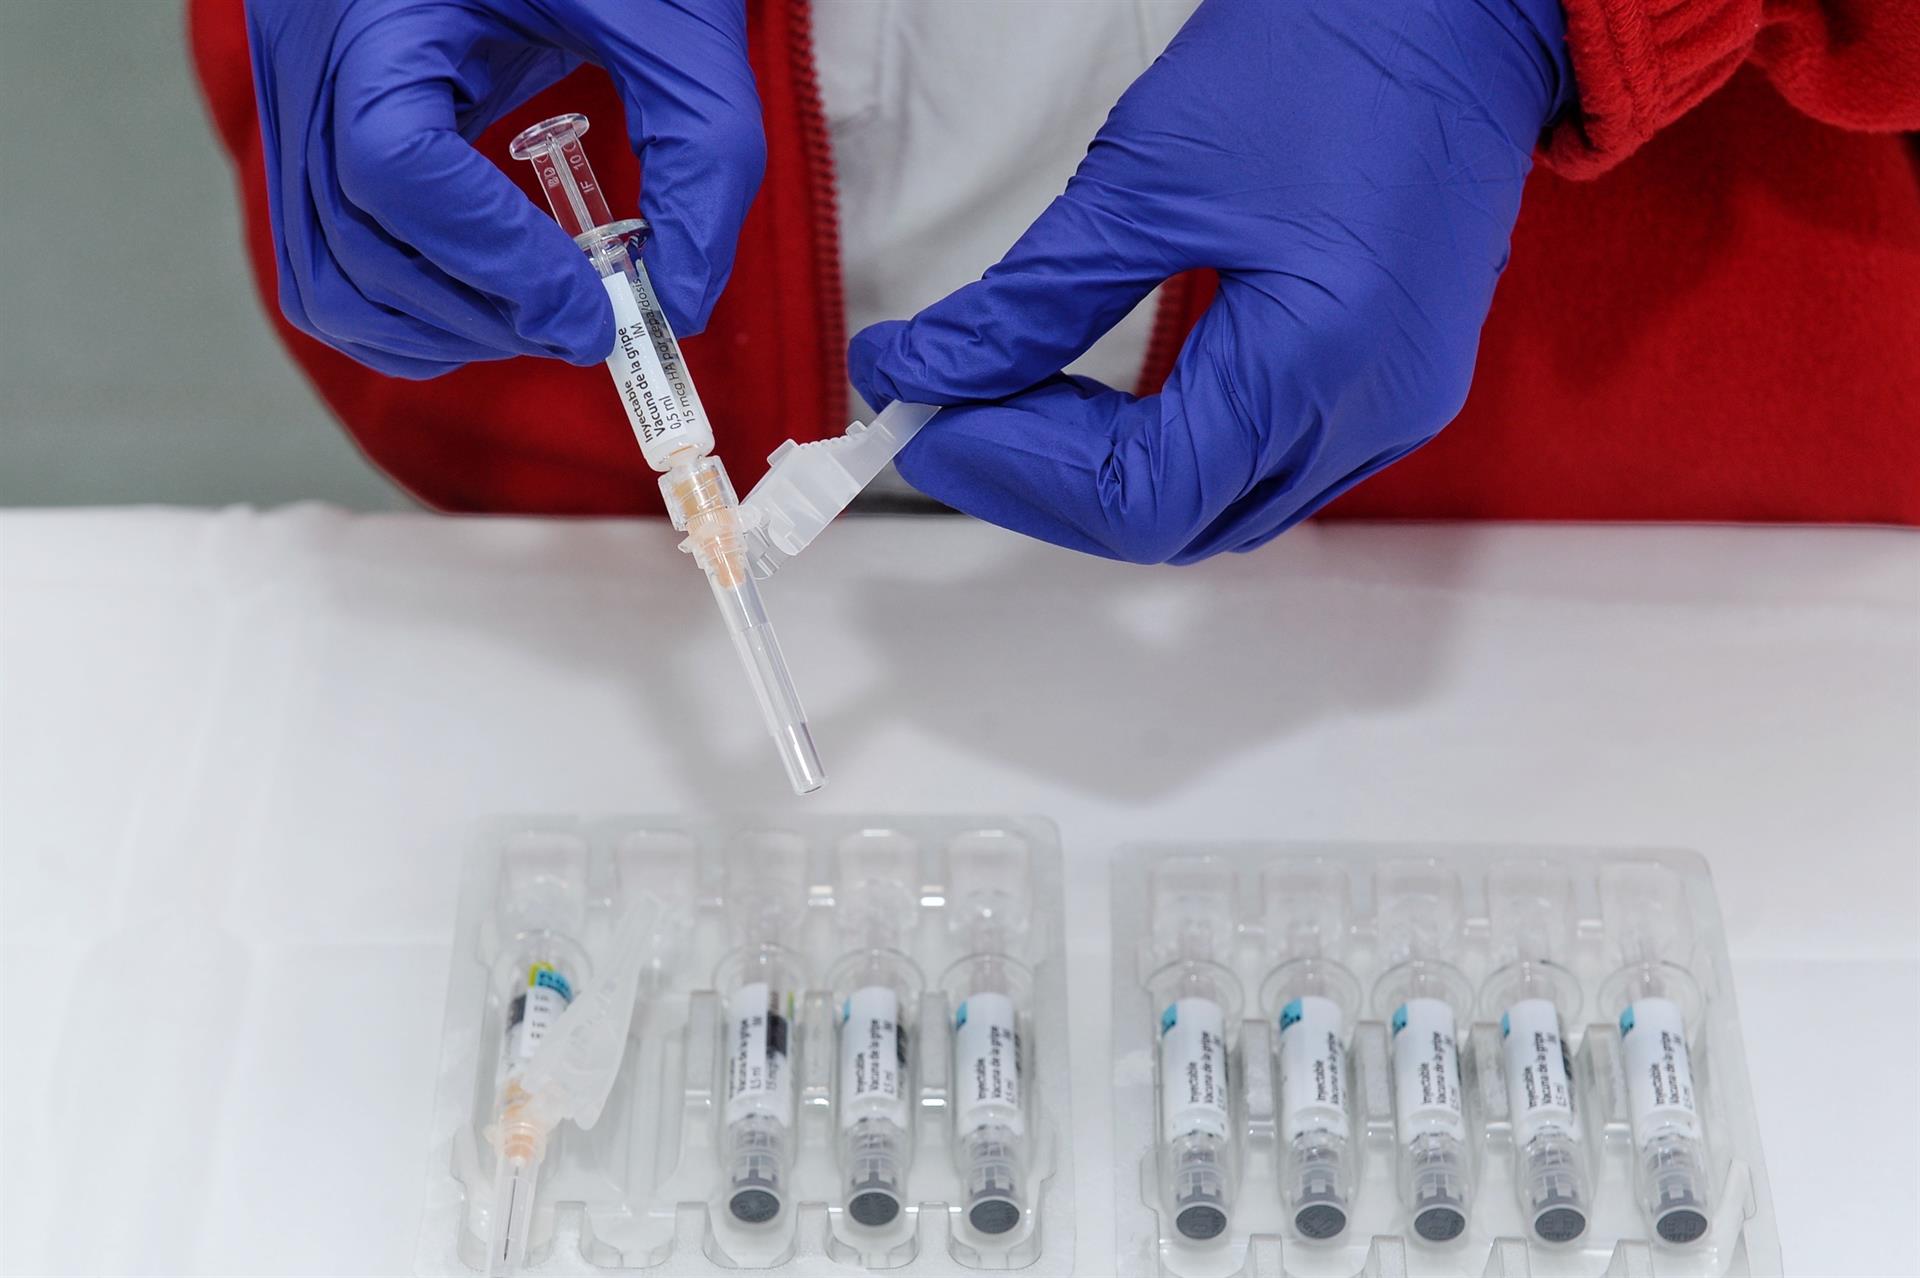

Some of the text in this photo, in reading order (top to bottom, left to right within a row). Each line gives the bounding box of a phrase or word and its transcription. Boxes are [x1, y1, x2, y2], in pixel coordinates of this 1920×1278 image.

[630, 322, 646, 337] IM
[632, 278, 696, 424] 15 mcg HA por cepa/dosis
[618, 327, 666, 437] Vacuna de la gripe
[625, 381, 654, 443] Inyectable
[658, 395, 682, 430] 0,5 ml
